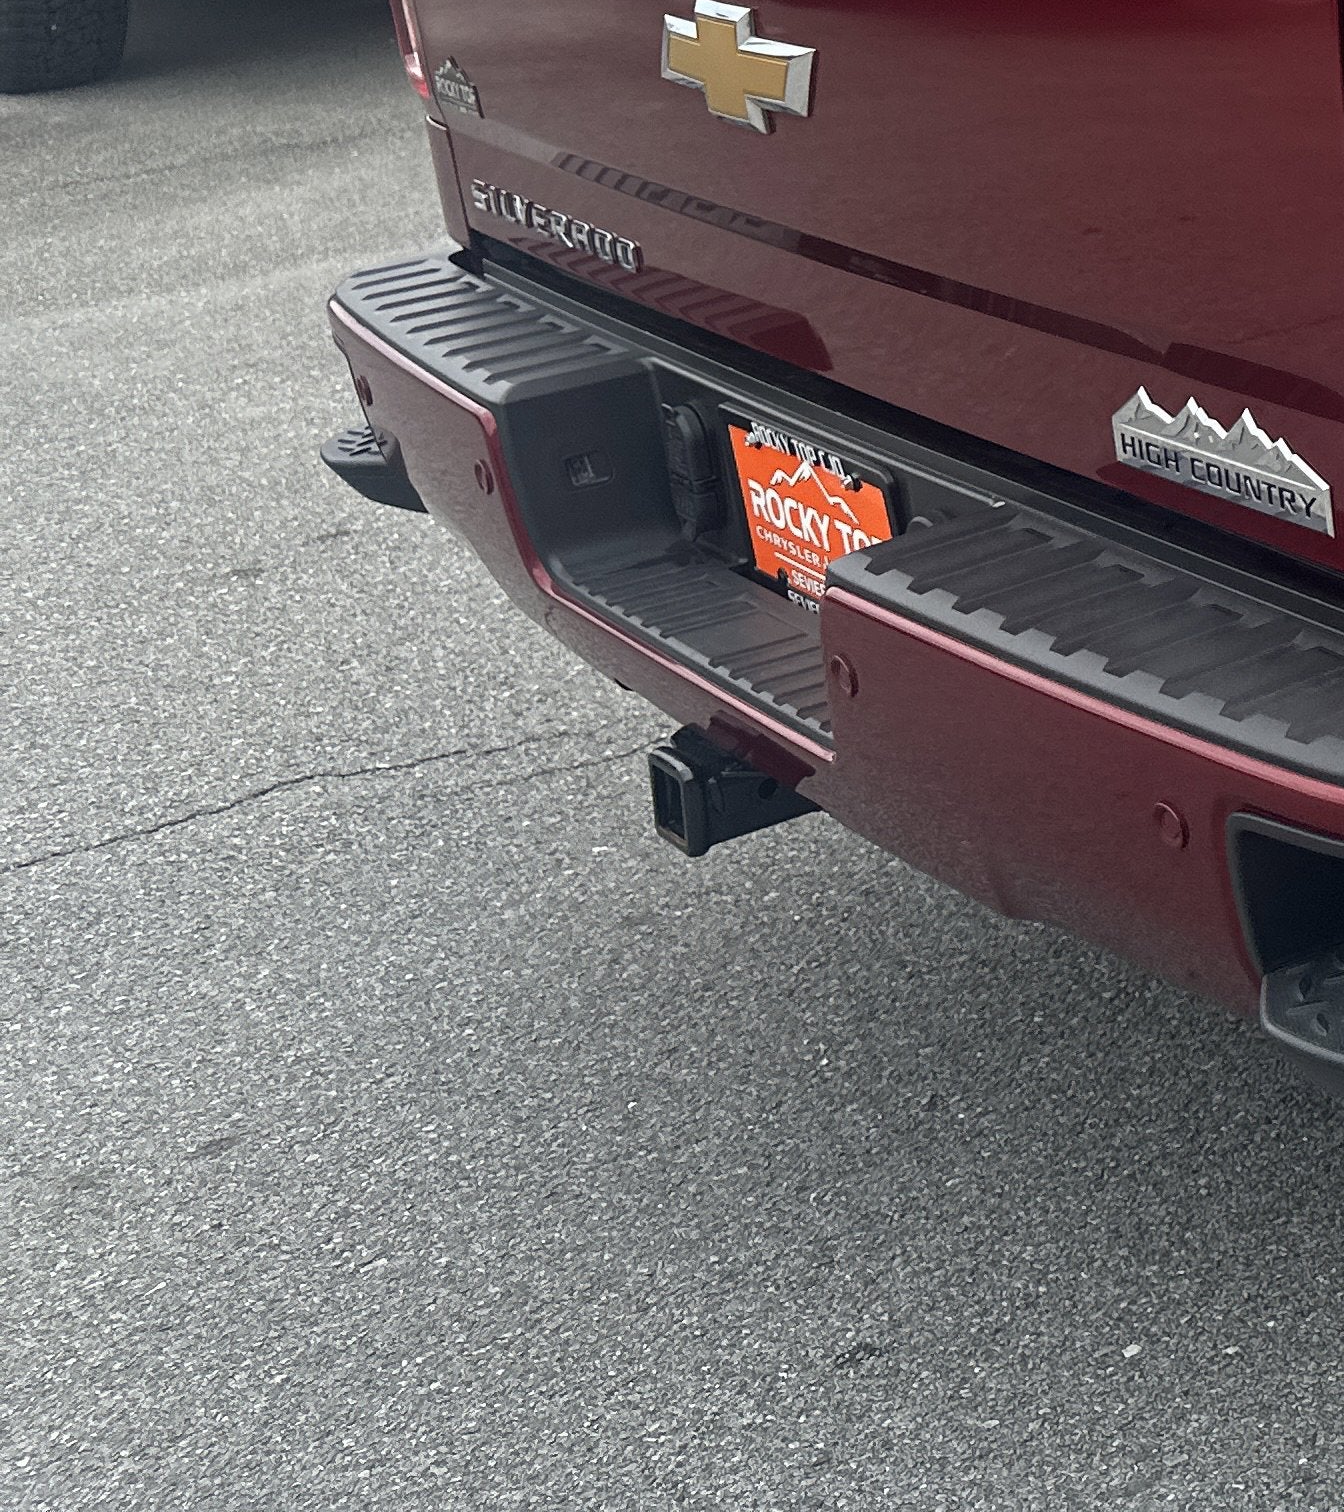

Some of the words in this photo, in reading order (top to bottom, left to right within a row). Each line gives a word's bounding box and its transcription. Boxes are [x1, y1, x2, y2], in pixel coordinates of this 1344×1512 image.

[471, 178, 645, 273] SILVERADO
[750, 421, 791, 457] ROCKY
[790, 438, 817, 467] TOP
[1119, 432, 1182, 474] HIGH
[1189, 456, 1318, 520] COUNTRY
[747, 478, 831, 553] ROCKY
[833, 518, 883, 555] TO
[755, 525, 821, 569] CHRYSLER
